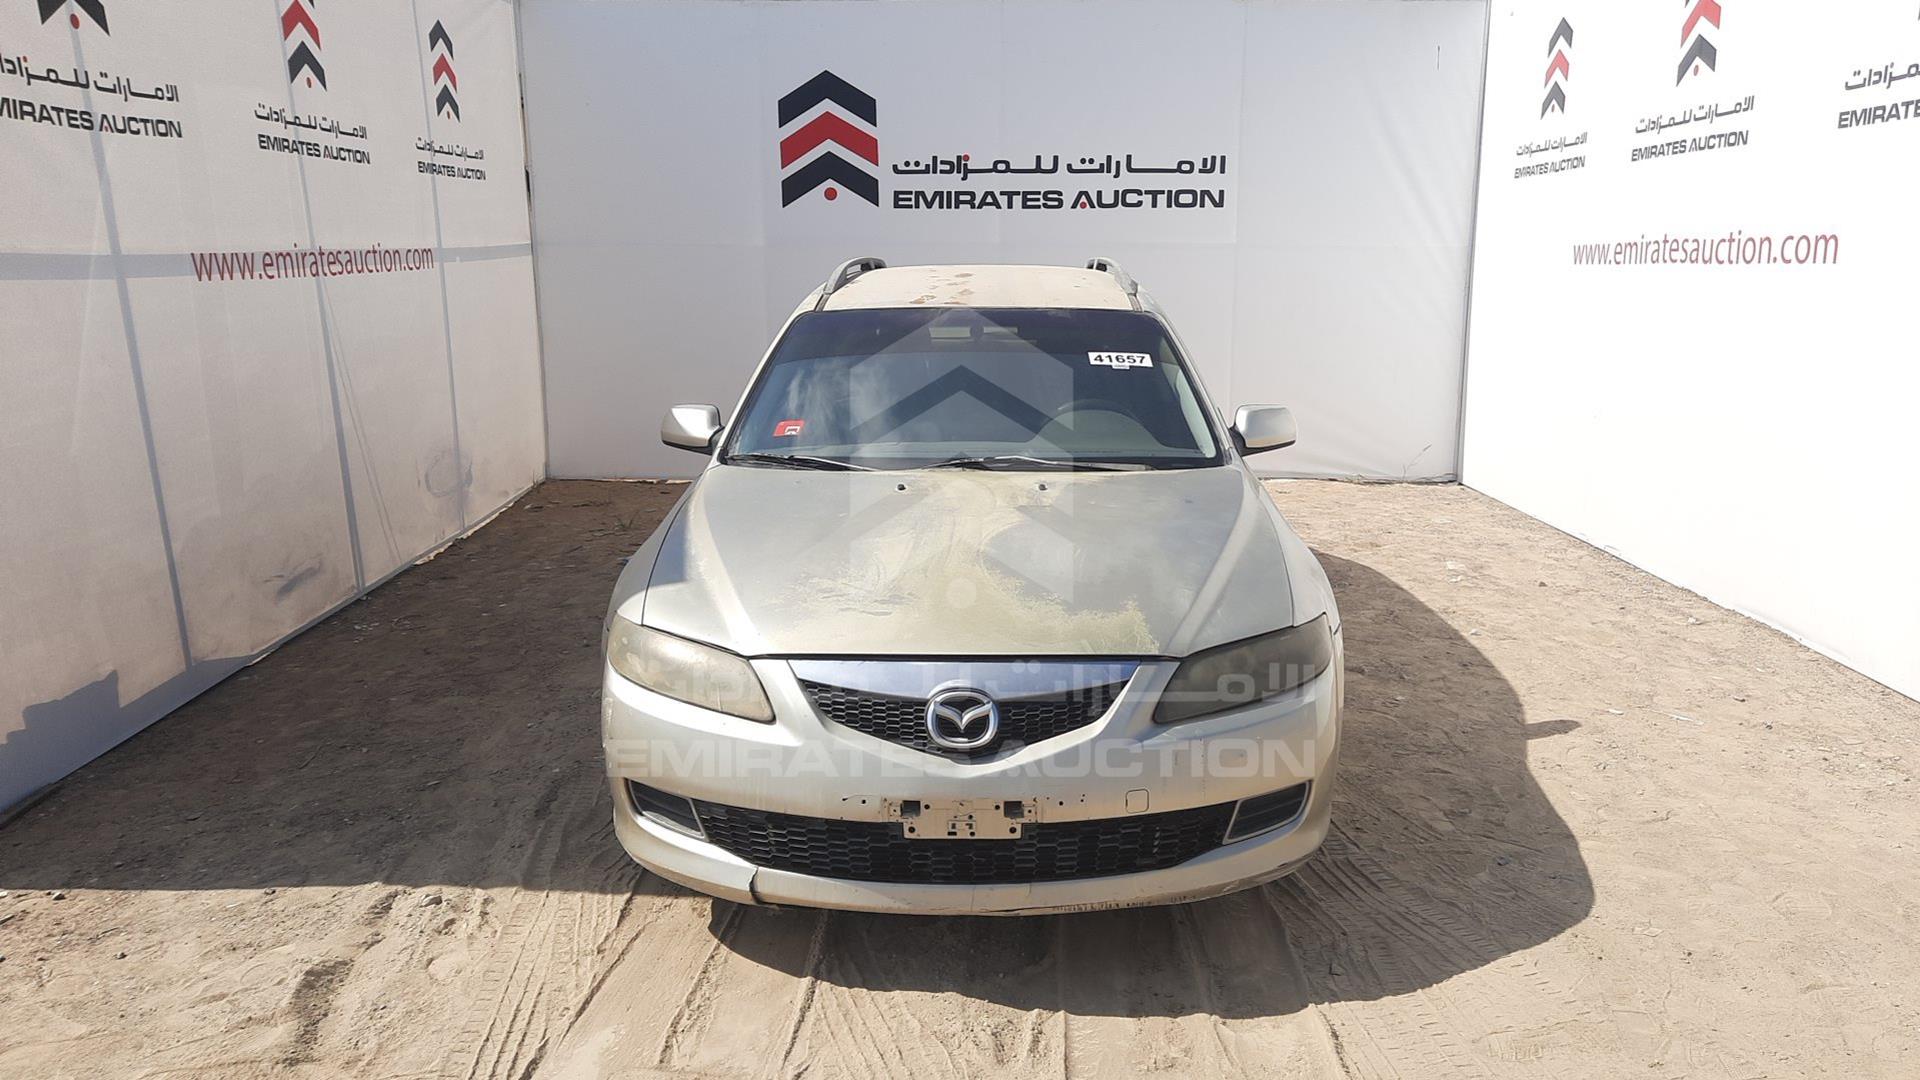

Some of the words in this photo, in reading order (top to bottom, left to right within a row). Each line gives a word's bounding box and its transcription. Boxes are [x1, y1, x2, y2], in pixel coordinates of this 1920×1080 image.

[99, 113, 183, 138] AUCTION
[257, 133, 322, 158] EMIRATES
[323, 144, 371, 165] AUCTION
[1631, 138, 1687, 162] EMIRATES
[1688, 129, 1749, 153] AUCTION
[417, 160, 456, 177] EMIRATES
[457, 167, 486, 181] AUCTION
[1514, 161, 1549, 179] EMIRATES
[1549, 155, 1586, 173] AUCTION
[892, 189, 1064, 210] EMIRATES
[1070, 187, 1225, 210] AUCTION
[1572, 229, 1840, 266] www.emiratesauction.com
[190, 242, 435, 282] www.emiratesauction.com
[1093, 353, 1147, 364] 41657
